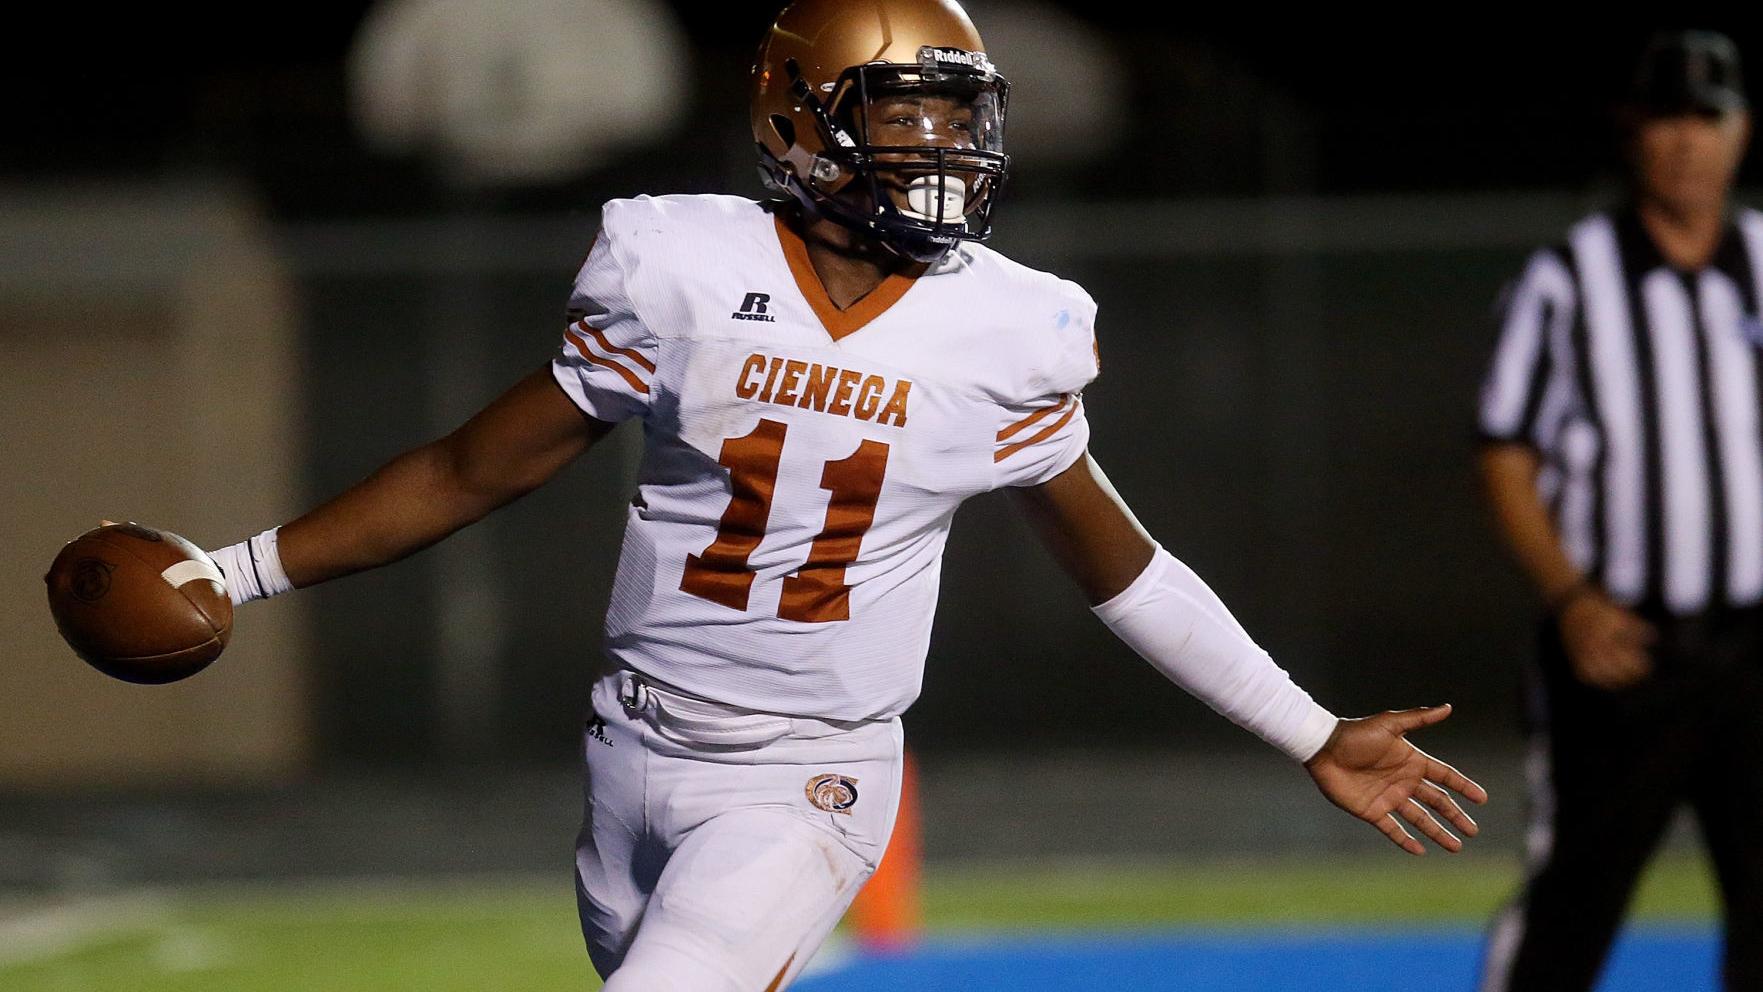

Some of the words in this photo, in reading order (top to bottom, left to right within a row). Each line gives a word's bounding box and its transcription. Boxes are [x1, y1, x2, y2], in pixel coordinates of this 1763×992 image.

[933, 49, 974, 66] Riddell
[739, 292, 771, 314] R
[731, 312, 776, 323] RUSSELL
[735, 353, 912, 428] CIENEGA
[678, 417, 890, 623] 11
